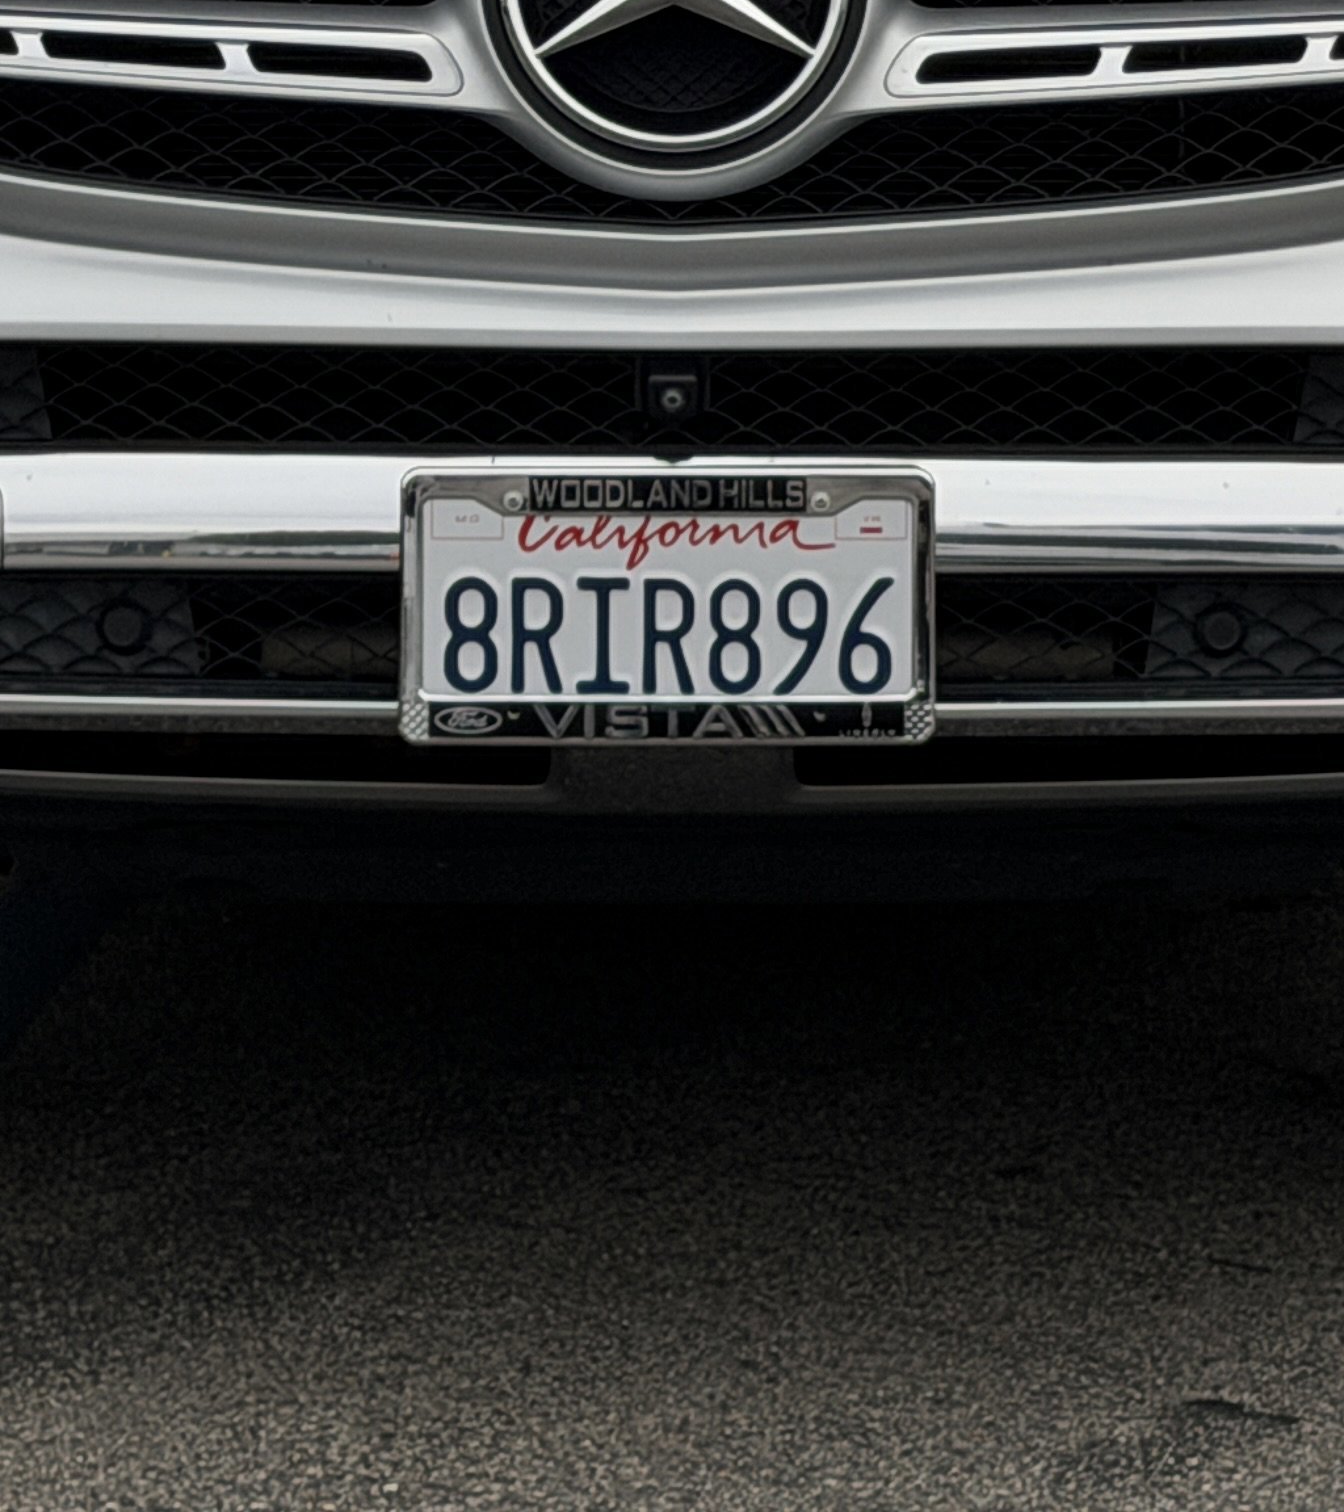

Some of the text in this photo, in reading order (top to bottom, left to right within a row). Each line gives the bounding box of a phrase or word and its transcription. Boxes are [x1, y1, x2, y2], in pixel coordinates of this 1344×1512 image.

[533, 478, 804, 509] WOODLAND HILLS
[518, 515, 837, 571] California
[443, 576, 896, 695] 8RIR896
[533, 704, 743, 737] VISTA
